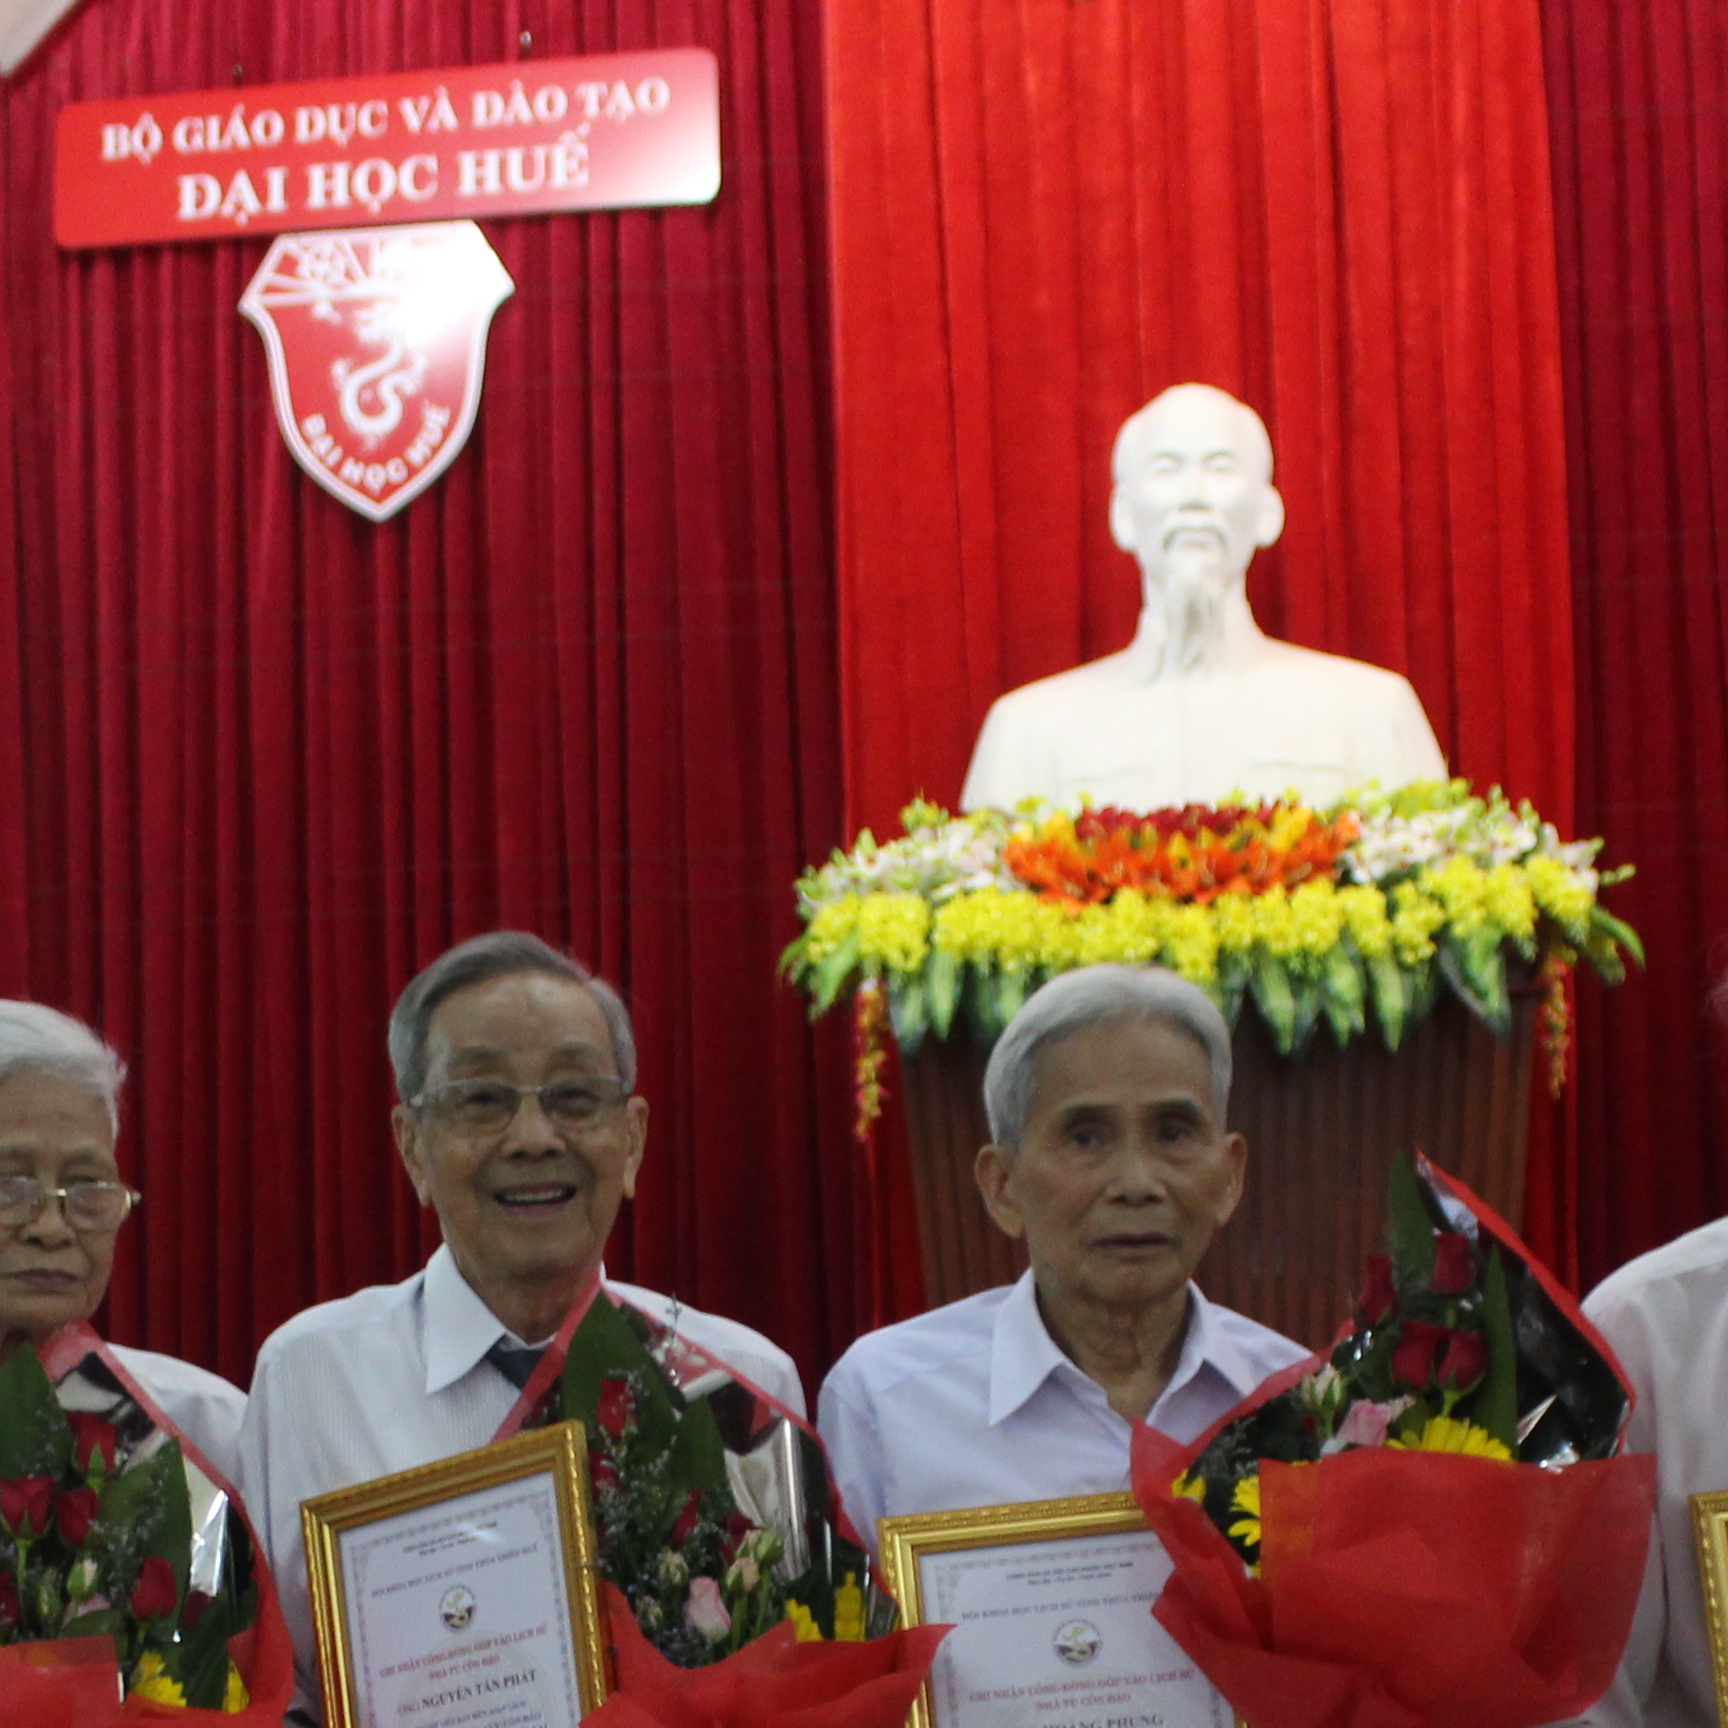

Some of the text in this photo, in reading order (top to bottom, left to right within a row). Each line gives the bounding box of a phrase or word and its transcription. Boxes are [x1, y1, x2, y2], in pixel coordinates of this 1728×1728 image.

[101, 112, 164, 165] BỘ
[172, 102, 286, 154] GIÁO
[294, 98, 390, 147] DỤC
[397, 84, 460, 134] VÀ
[575, 76, 672, 123] TẠO
[306, 153, 439, 216] HỌC
[457, 121, 592, 197] HUẾ
